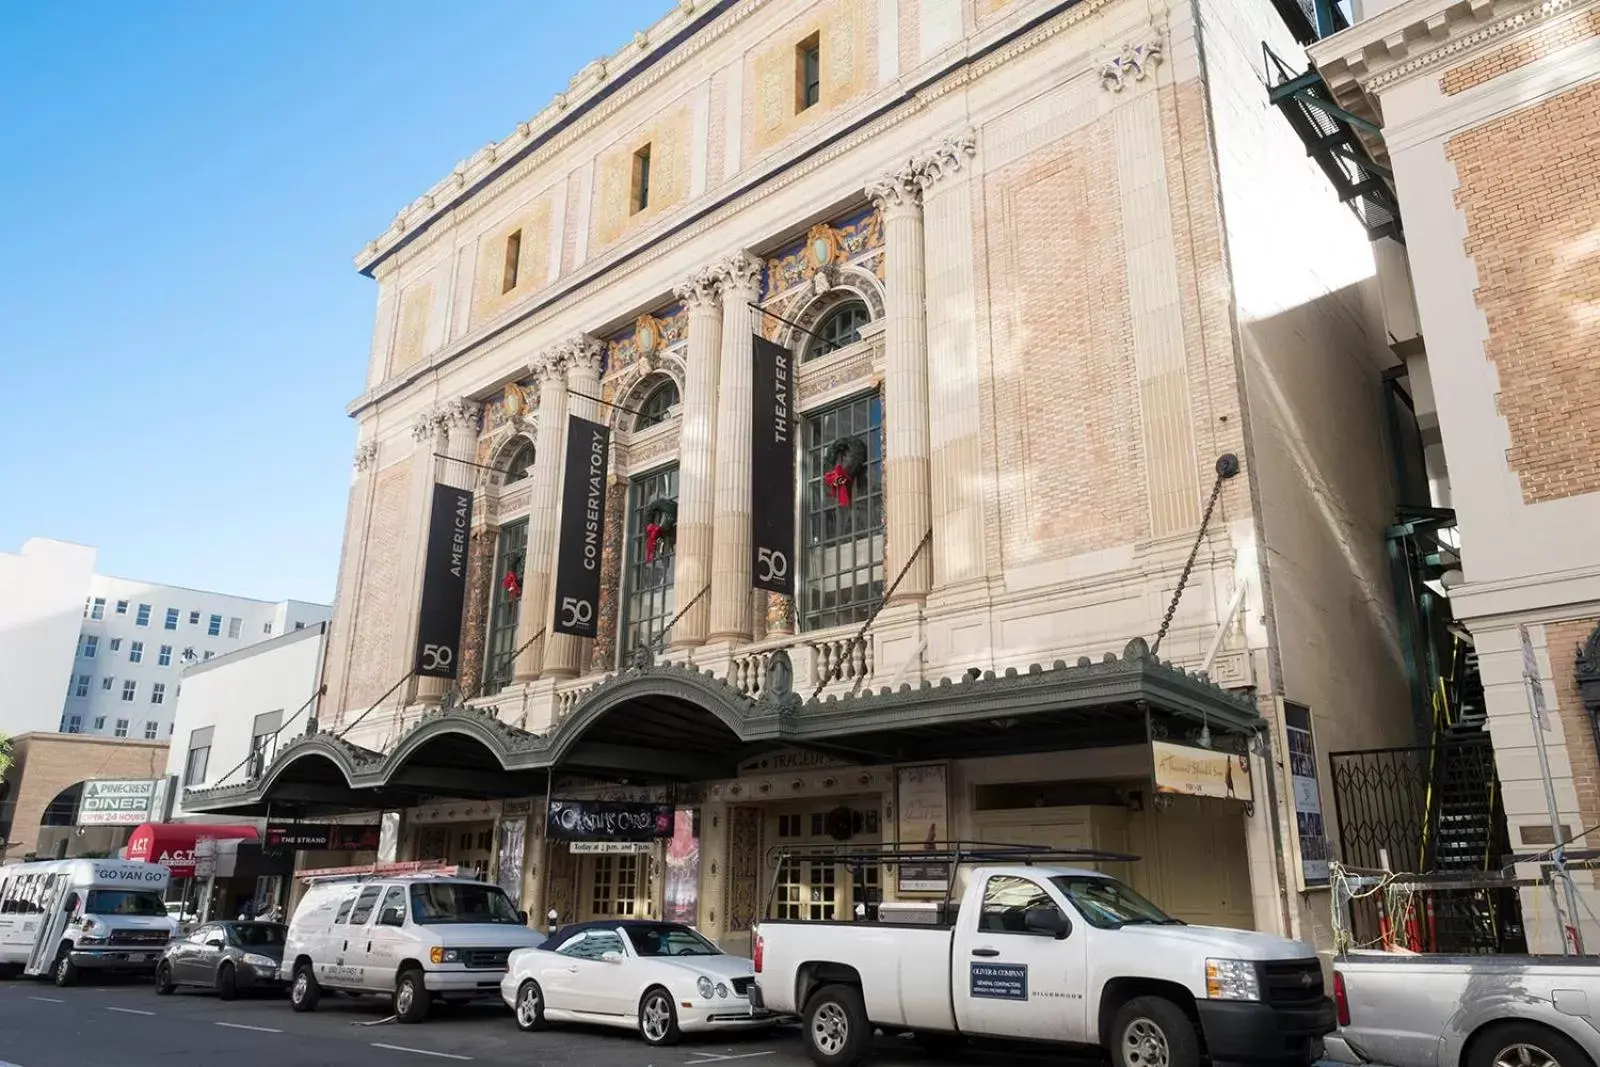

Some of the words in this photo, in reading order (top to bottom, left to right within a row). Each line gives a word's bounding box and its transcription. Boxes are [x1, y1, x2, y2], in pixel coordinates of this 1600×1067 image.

[775, 354, 787, 443] THEATER
[583, 431, 604, 570] CONSERVATORY
[450, 496, 468, 577] AMERICAN
[757, 546, 787, 581] 50
[561, 597, 592, 628] 50
[422, 643, 452, 670] 50
[101, 783, 150, 794] PINECREST
[84, 798, 147, 809] DINER
[105, 813, 118, 821] 24
[119, 813, 145, 821] HOURS
[160, 850, 196, 860] A.C.T.
[120, 871, 142, 880] VAN
[998, 969, 1025, 977] COMPANY
